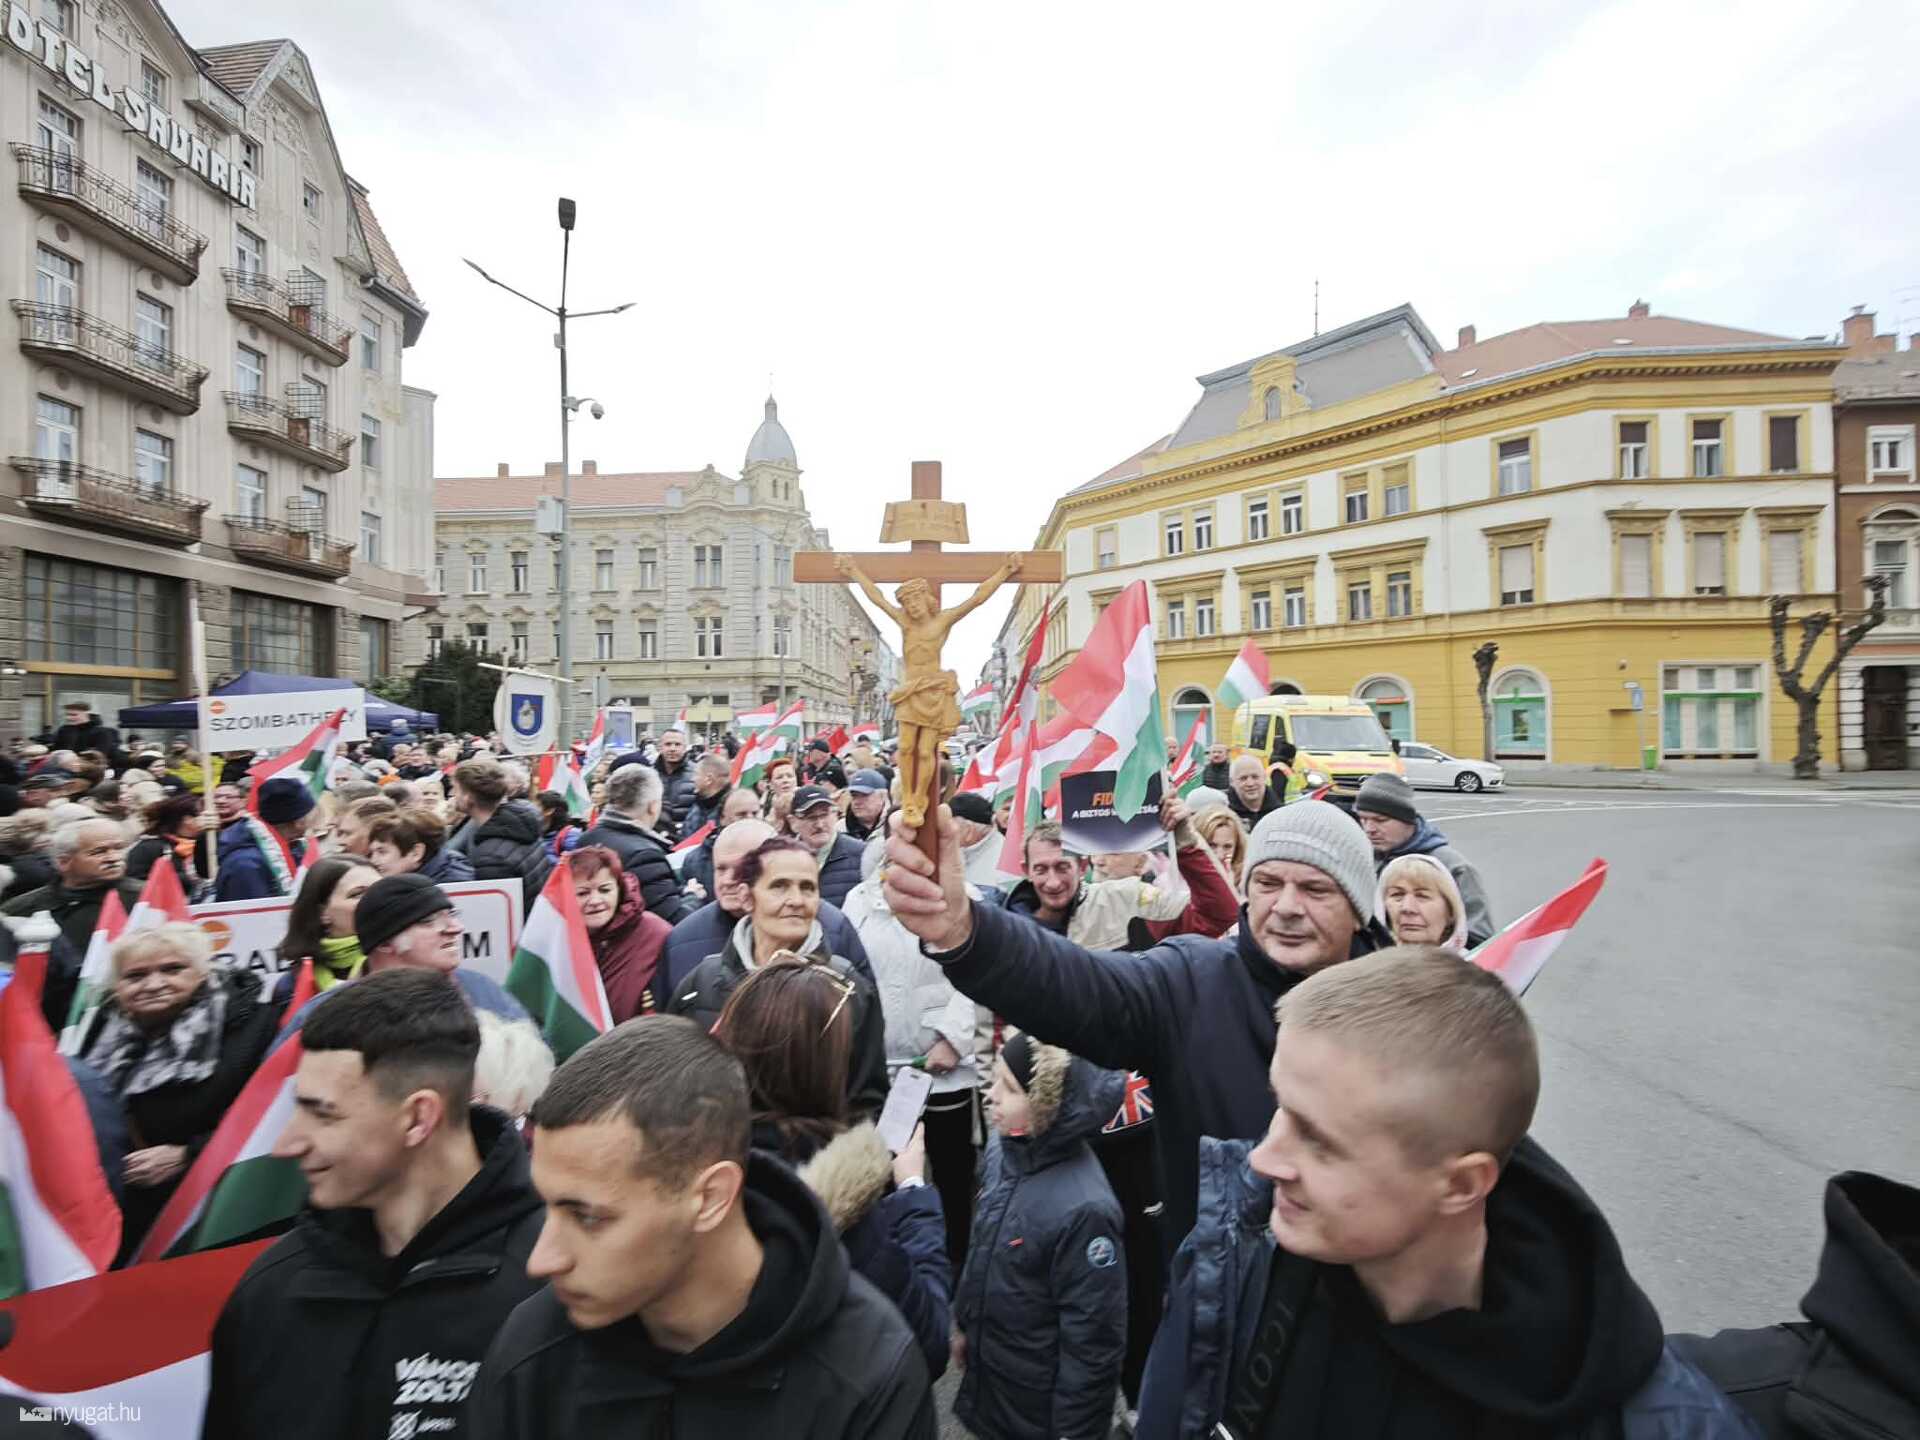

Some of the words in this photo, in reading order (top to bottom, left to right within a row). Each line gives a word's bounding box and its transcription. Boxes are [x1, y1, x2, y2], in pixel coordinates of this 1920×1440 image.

[0, 2, 115, 112] OTEL
[123, 86, 257, 211] SAVARIA
[209, 708, 358, 732] SZOMBATHY
